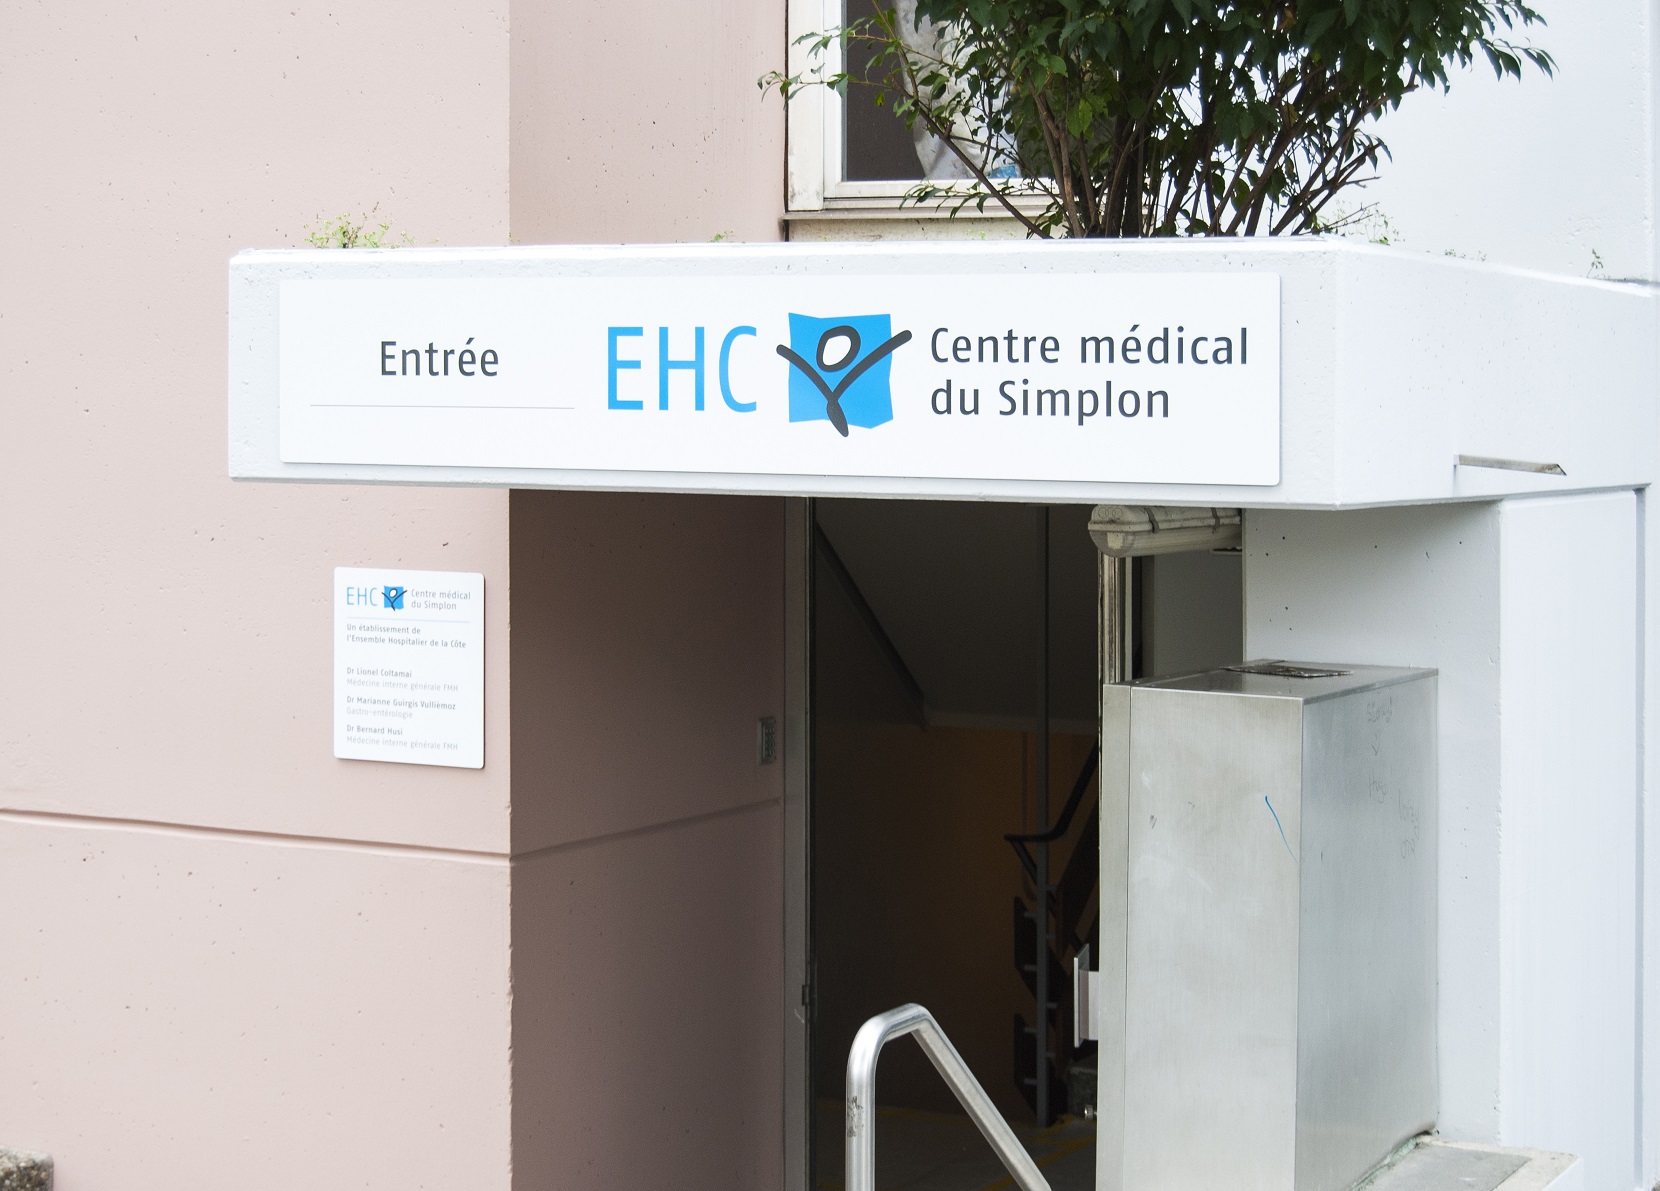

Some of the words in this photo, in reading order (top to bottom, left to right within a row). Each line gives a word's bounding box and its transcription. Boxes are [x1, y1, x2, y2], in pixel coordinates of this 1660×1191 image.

[931, 327, 1060, 366] Centre
[1080, 324, 1247, 367] médical
[380, 337, 499, 377] Entrée
[607, 325, 757, 413] EHC
[931, 379, 979, 416] du
[998, 379, 1169, 427] Simplon
[347, 586, 378, 606] EHC
[410, 588, 437, 599] Centre
[439, 588, 471, 601] médical
[410, 600, 422, 609] du
[424, 601, 457, 610] Simplon
[347, 623, 357, 632] Un
[358, 624, 410, 634] établissement
[411, 626, 421, 634] de
[388, 637, 428, 648] Hospitalier
[429, 639, 439, 647] de
[441, 640, 449, 648] la
[450, 640, 467, 649] Côte
[347, 667, 355, 675] Dr
[356, 668, 379, 676] Lionel
[347, 678, 381, 687] Médecine
[382, 681, 408, 689] interne
[410, 682, 442, 691] générale
[443, 683, 459, 691] FMH
[347, 696, 355, 704] Dr
[356, 697, 391, 706] Marianne
[392, 698, 419, 708] Guirgis
[347, 724, 355, 732] Dr
[356, 725, 385, 735] Bernard
[387, 727, 403, 736] Husi
[347, 735, 381, 745] Médecine
[382, 738, 408, 747] interne
[410, 740, 442, 750] générale
[443, 742, 459, 750] FMH
